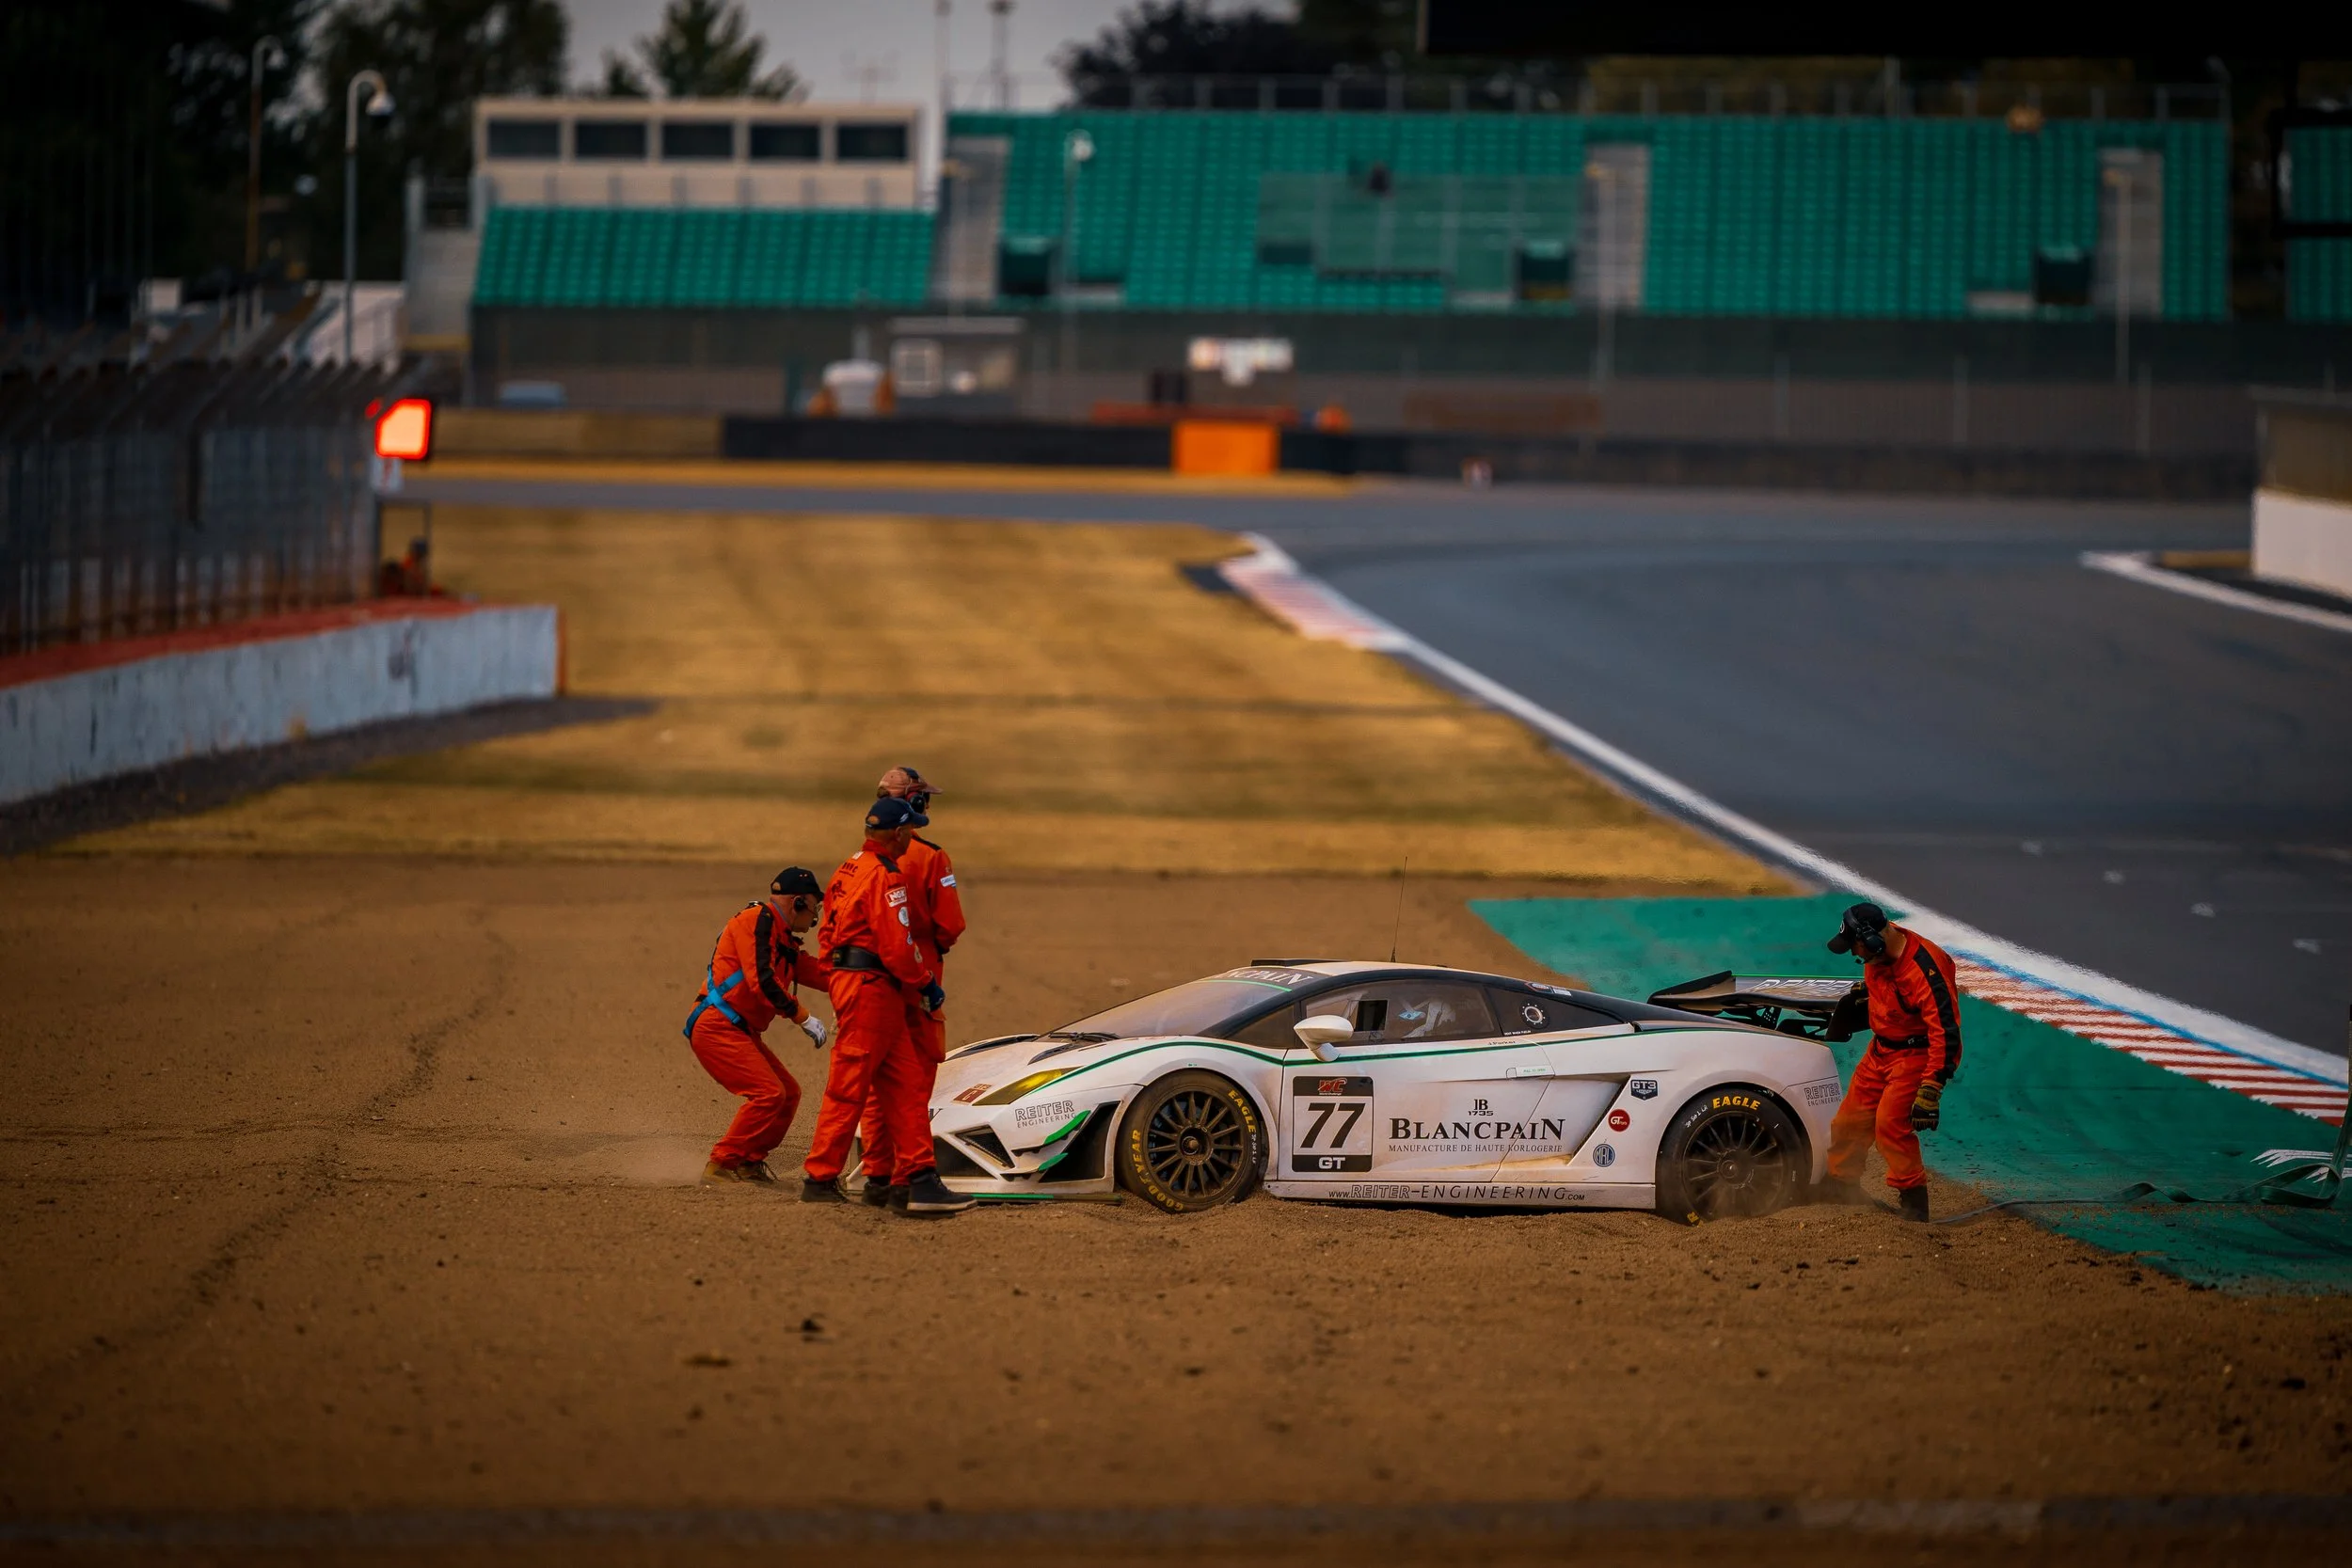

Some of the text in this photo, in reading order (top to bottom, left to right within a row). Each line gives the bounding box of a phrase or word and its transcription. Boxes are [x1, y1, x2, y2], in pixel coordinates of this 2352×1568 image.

[1631, 1081, 1657, 1089] GT3
[1804, 1082, 1841, 1101] REITER
[1015, 1100, 1075, 1122] REITER
[1228, 1089, 1257, 1133] EAGLE
[1712, 1096, 1762, 1111] EAGLE
[1017, 1111, 1076, 1128] ENGINEERING
[1300, 1102, 1366, 1148] 77
[1389, 1117, 1566, 1141] BLANCPAIN
[1389, 1144, 1457, 1152] MANUFACTURE
[1460, 1144, 1472, 1152] DE
[1475, 1144, 1505, 1152] HAUTE
[1318, 1156, 1346, 1169] GT
